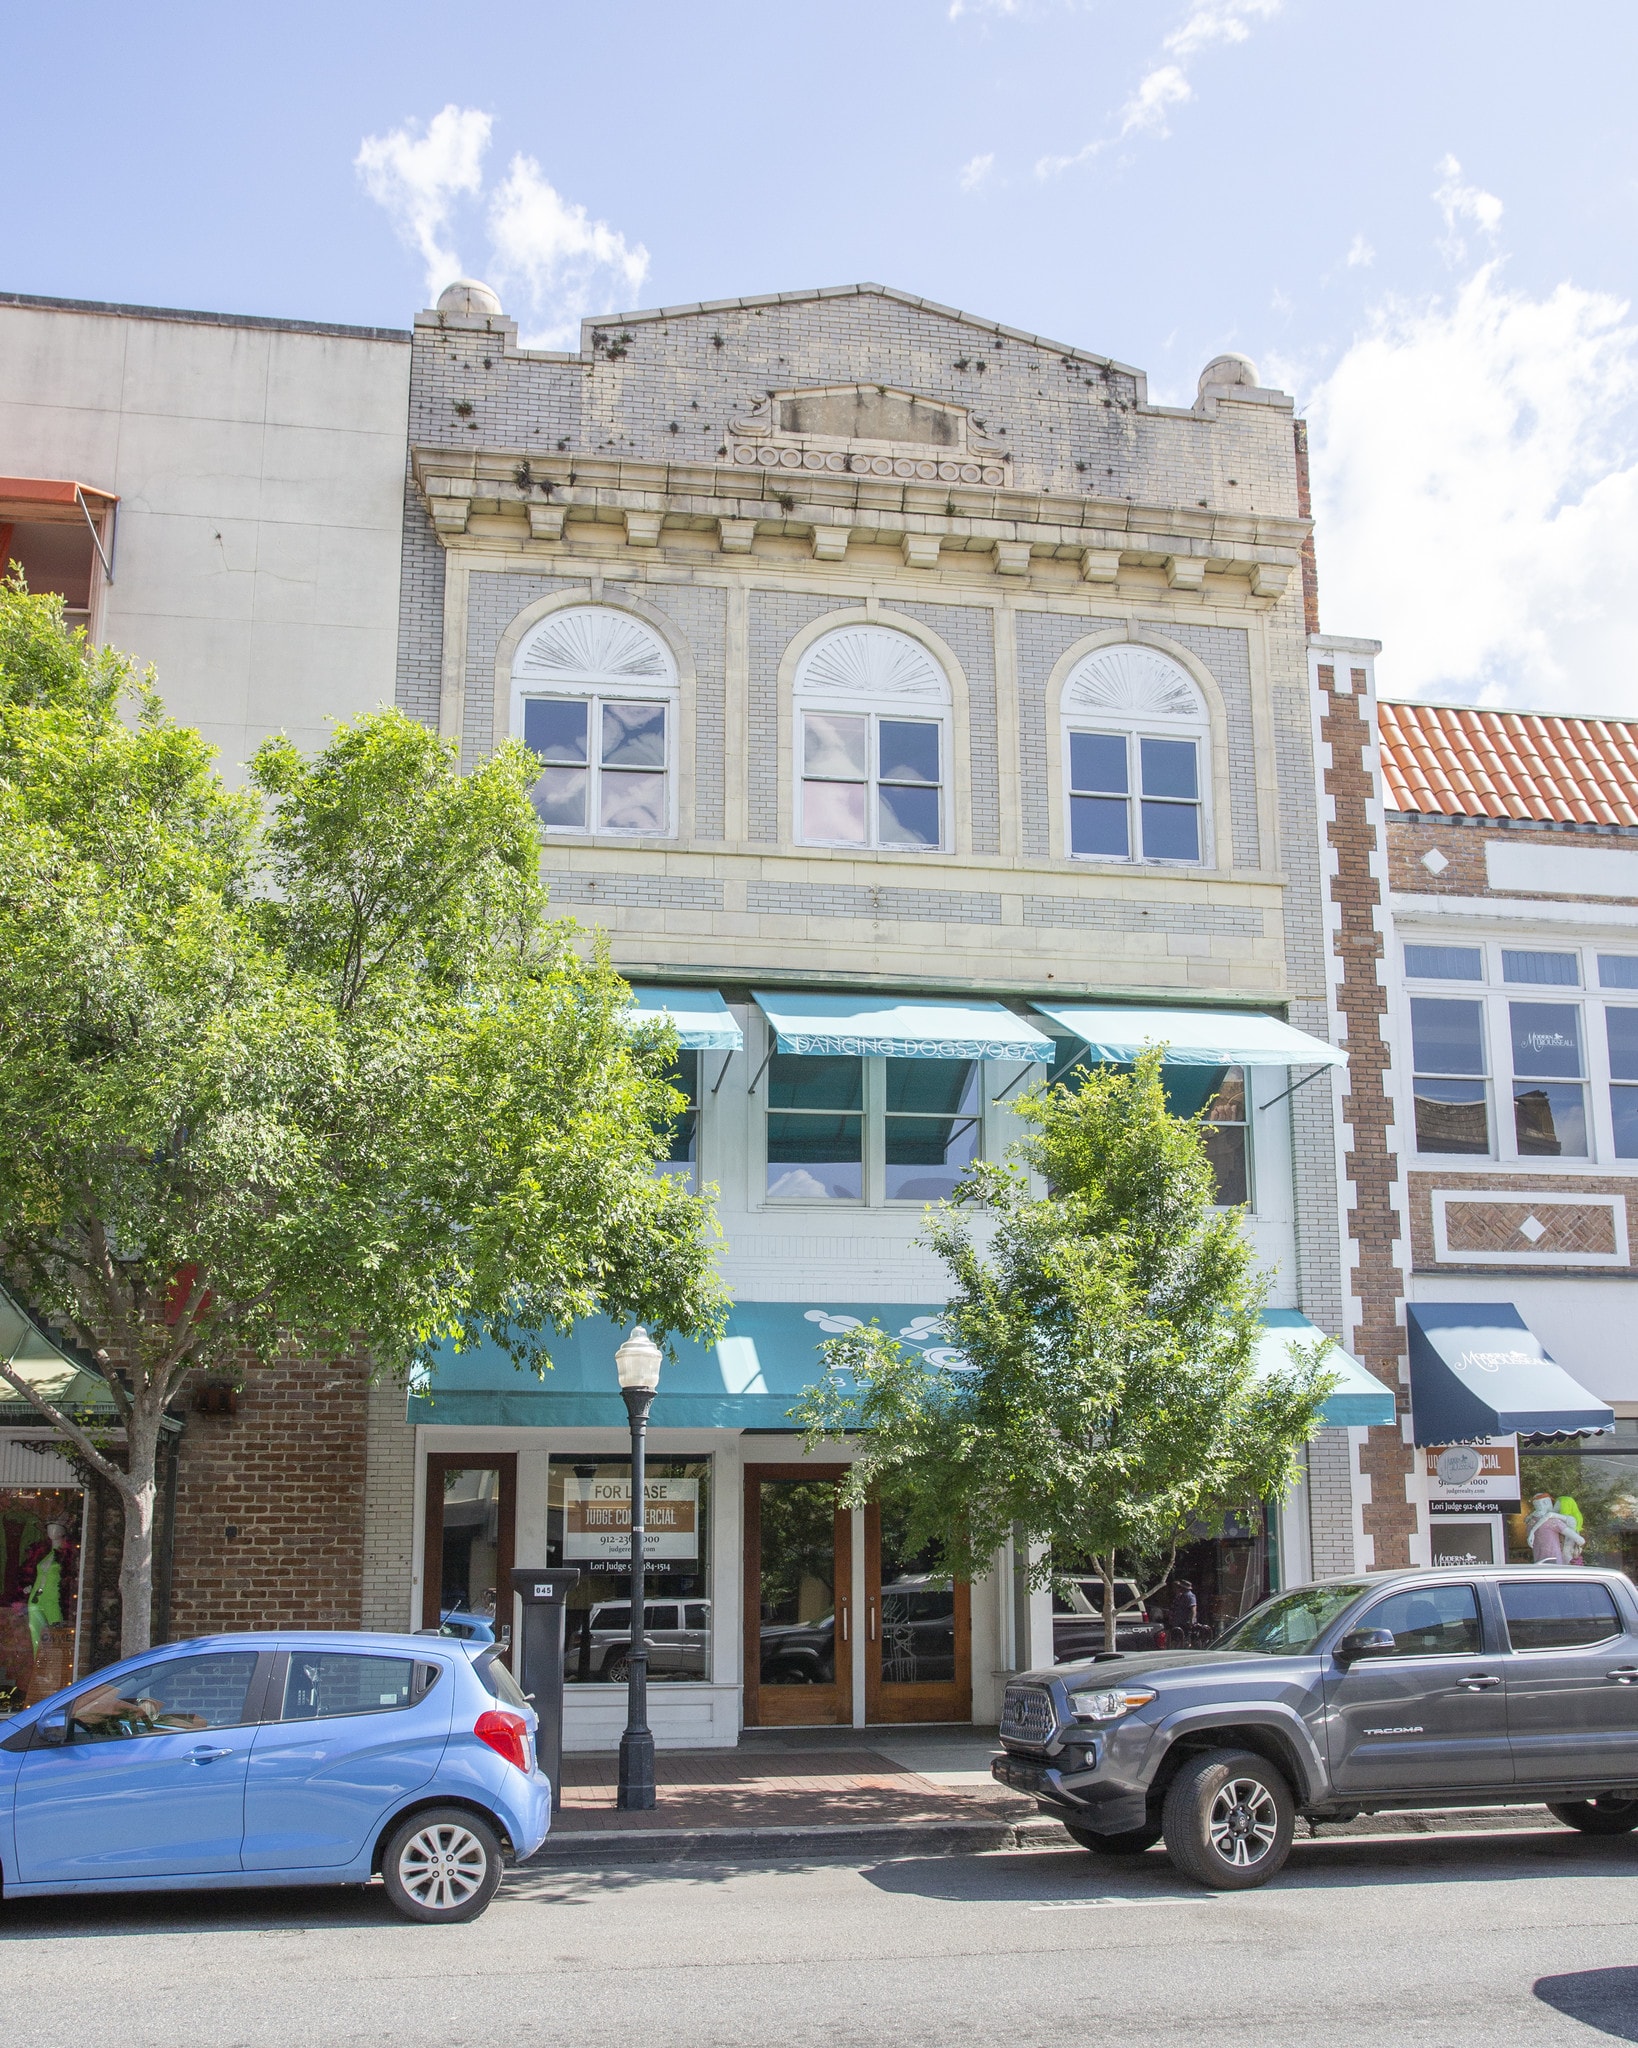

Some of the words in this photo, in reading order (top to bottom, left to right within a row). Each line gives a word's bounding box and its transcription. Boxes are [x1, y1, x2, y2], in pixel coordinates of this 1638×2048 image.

[796, 1036, 895, 1055] DANCING
[905, 1039, 967, 1057] DOGS
[975, 1042, 1038, 1060] YOGA
[594, 1485, 621, 1499] FOR
[625, 1485, 667, 1499] LASE
[1431, 1502, 1444, 1510] Lori
[1445, 1502, 1462, 1511] Judge
[1463, 1502, 1499, 1511] 912-484-1514
[585, 1508, 613, 1525] JUDGE
[615, 1508, 677, 1525] COERCIAL
[590, 1562, 605, 1571] Lori
[606, 1561, 626, 1573] Judge
[1363, 1726, 1424, 1736] TACOMA
